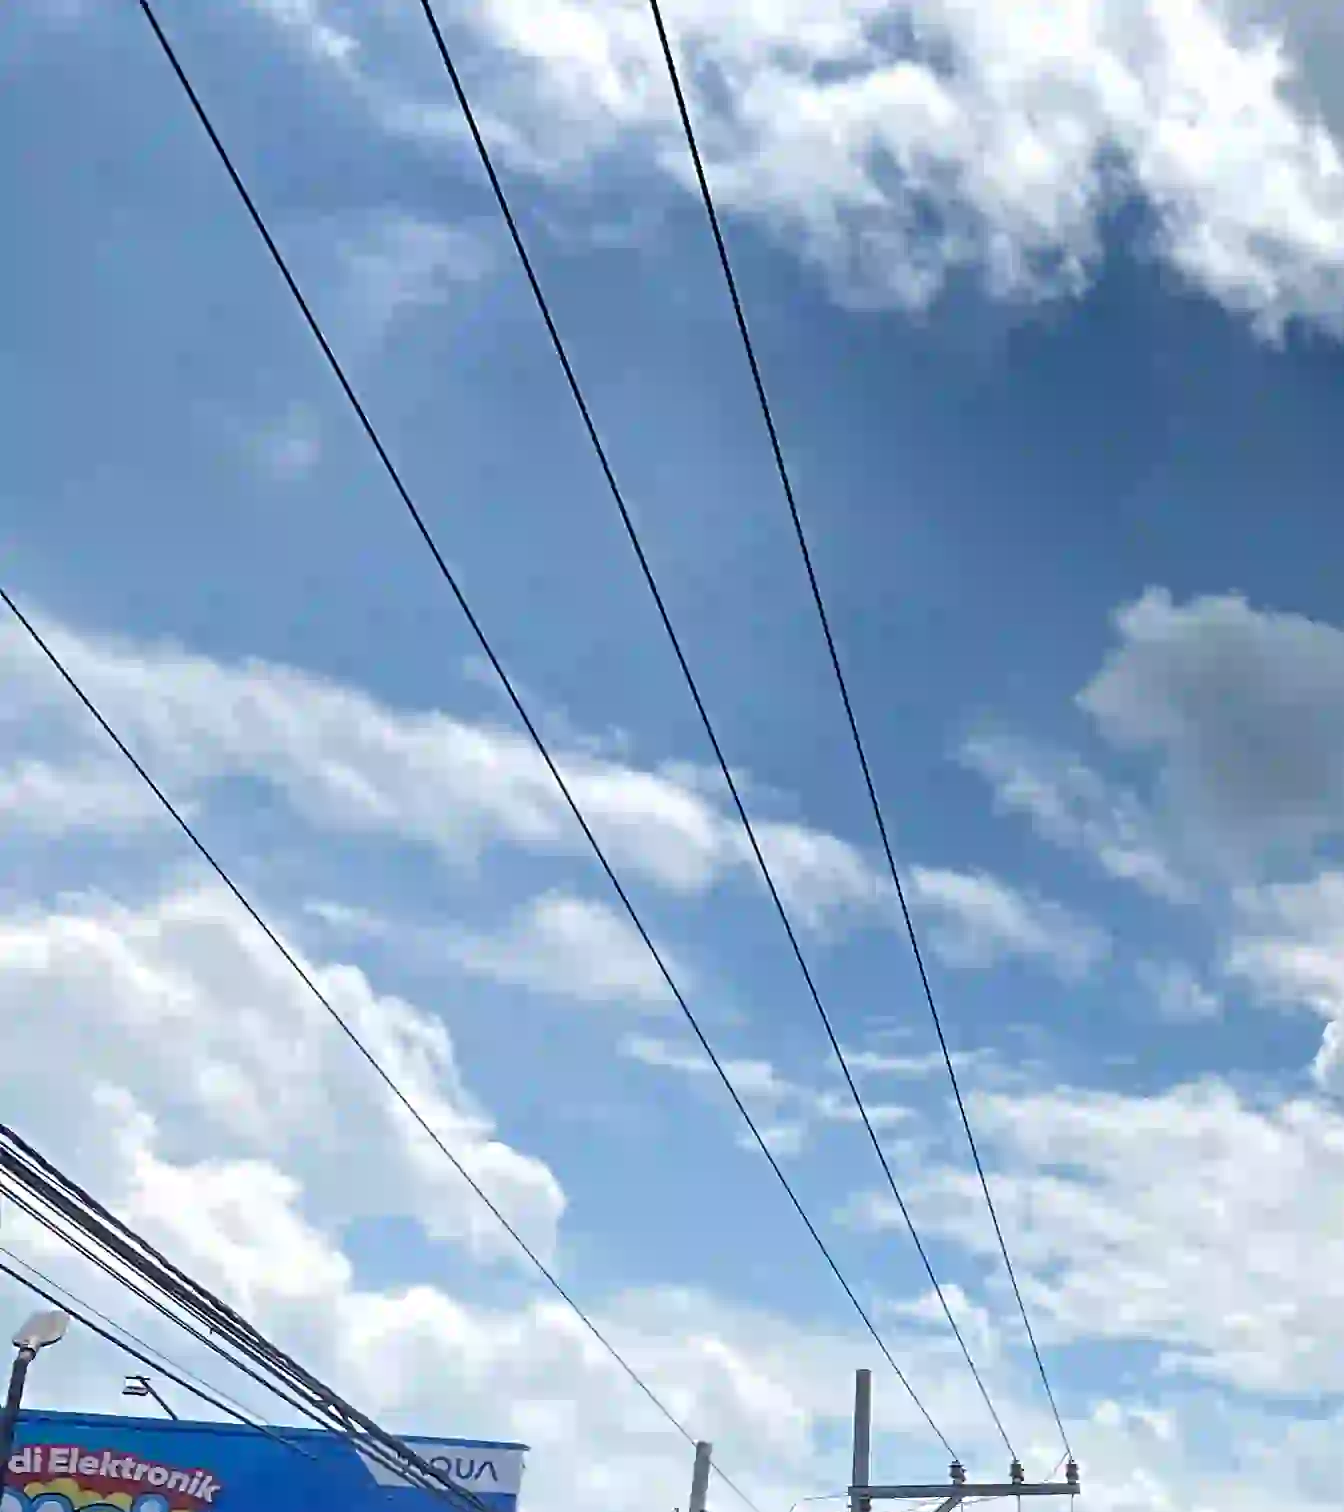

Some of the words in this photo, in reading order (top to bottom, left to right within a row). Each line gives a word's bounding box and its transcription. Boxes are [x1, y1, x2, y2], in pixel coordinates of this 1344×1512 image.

[8, 1448, 43, 1473] di
[48, 1447, 221, 1503] Elektronik
[408, 1455, 498, 1482] QUA
